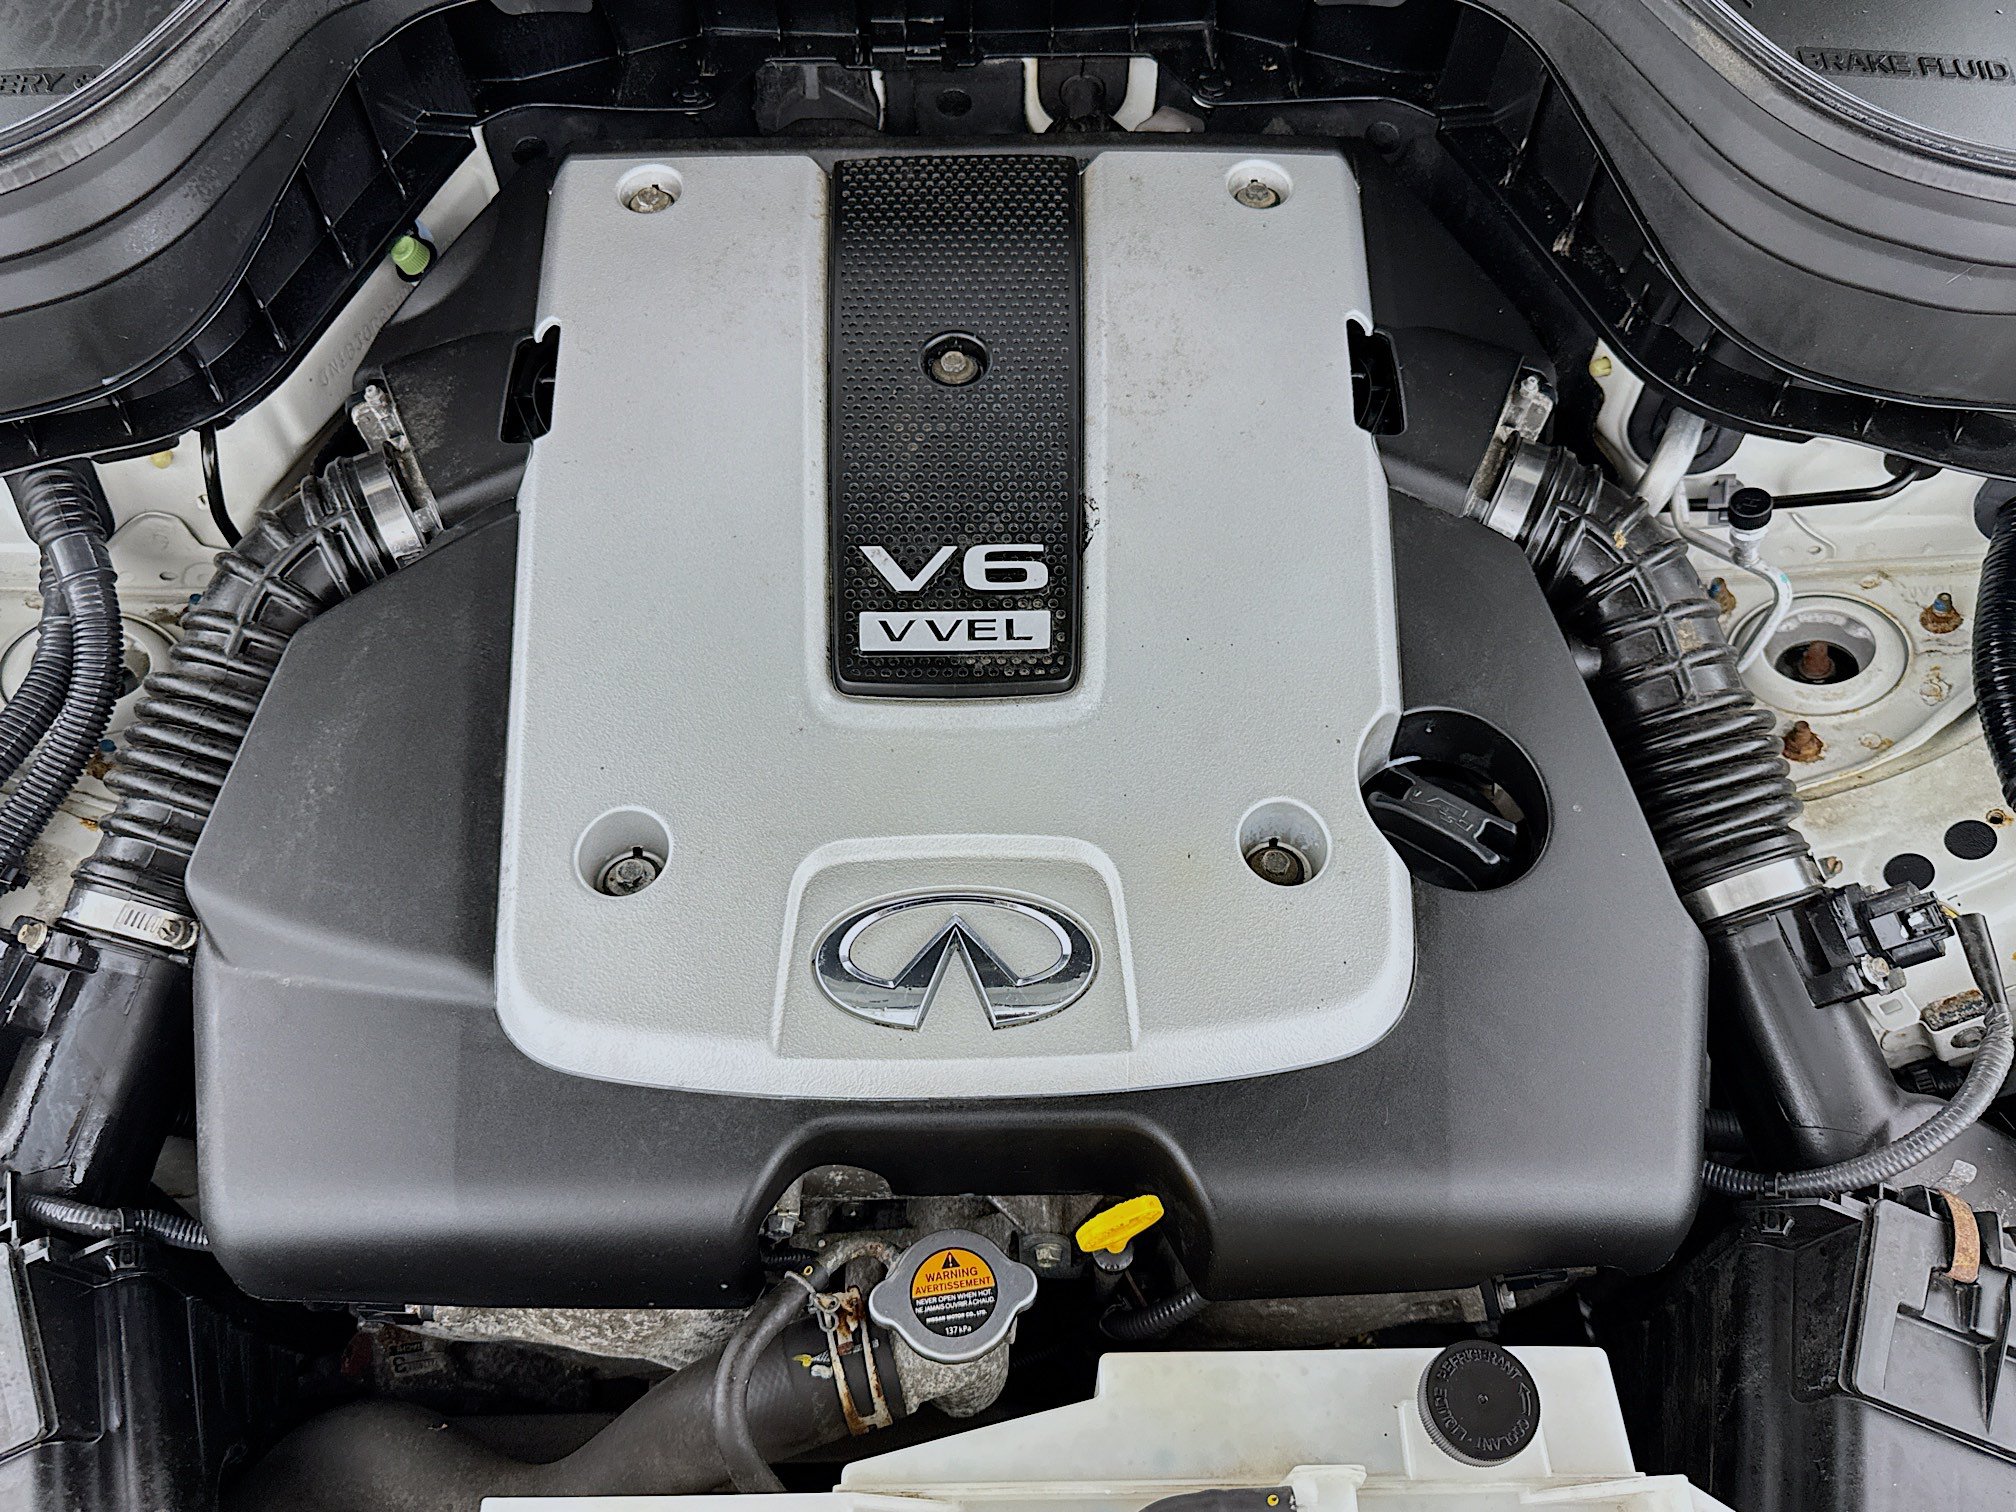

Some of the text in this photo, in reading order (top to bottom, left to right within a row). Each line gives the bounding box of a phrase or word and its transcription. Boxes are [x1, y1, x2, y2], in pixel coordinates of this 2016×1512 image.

[1798, 50, 2011, 80] BRAKE FLUID
[858, 543, 1049, 592] V6
[878, 618, 1034, 642] VVEL
[925, 1266, 978, 1283] WARNING
[915, 1275, 991, 1295] AVERTISSEMENT
[915, 1288, 993, 1306] NEVER OPEN WHEN HOT.
[924, 1303, 945, 1313] JAMAIS
[945, 1300, 968, 1310] OUVRIR
[945, 1325, 972, 1336] 137 kPa
[1474, 1418, 1530, 1451] COOLANT
